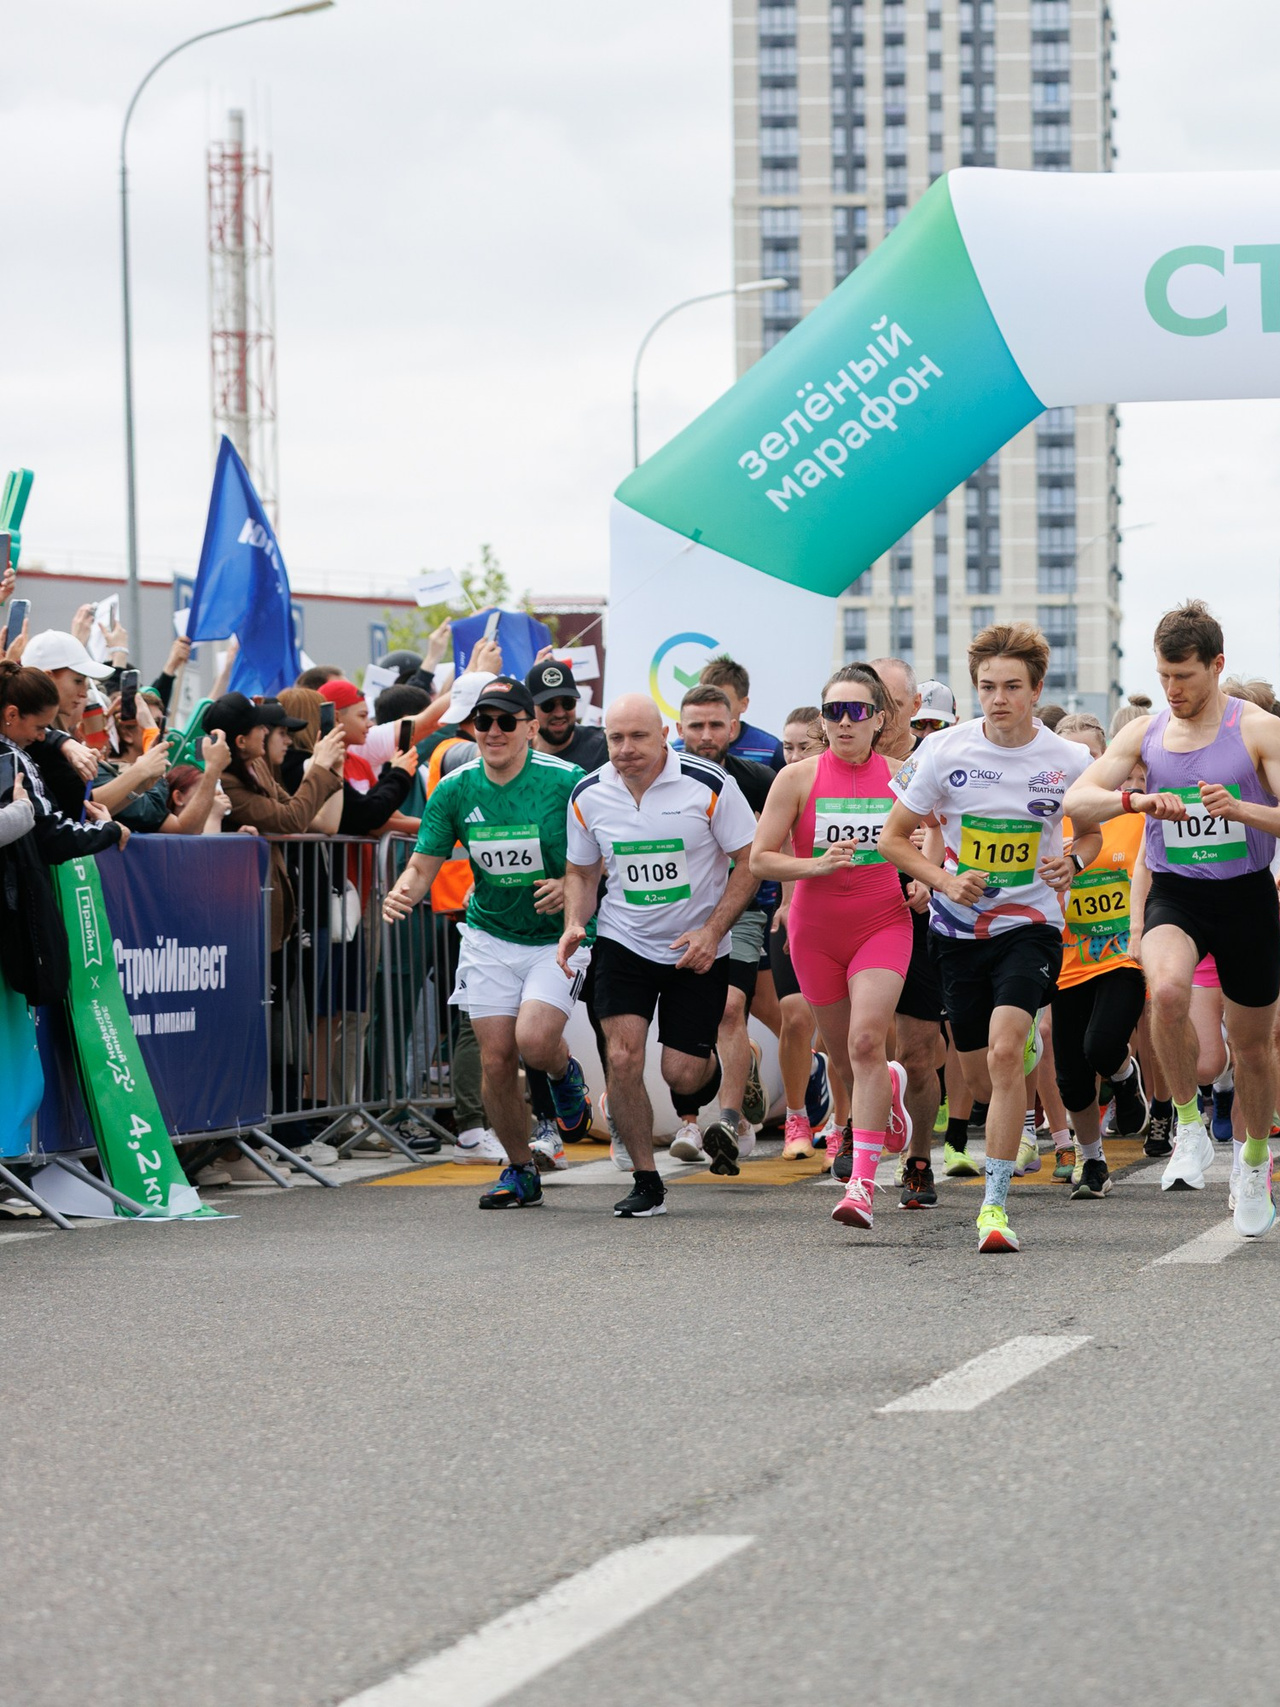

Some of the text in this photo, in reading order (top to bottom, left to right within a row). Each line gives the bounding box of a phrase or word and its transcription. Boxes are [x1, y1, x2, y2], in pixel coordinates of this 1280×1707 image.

[738, 315, 913, 481] зелёный
[765, 354, 944, 513] марафон
[1029, 786, 1065, 795] TRIATHLON
[826, 824, 884, 844] 0335
[1173, 814, 1230, 838] 1021
[481, 849, 533, 868] 0126
[973, 840, 1030, 864] 1103
[1191, 850, 1218, 861] 4,2км
[627, 862, 679, 883] 0108
[1072, 891, 1126, 917] 1302
[81, 895, 96, 952] Прайм
[112, 935, 228, 1001] СтройИнвест
[91, 999, 117, 1061] марафон
[154, 1007, 196, 1035] КОМПАНИЙ
[101, 1005, 128, 1064] зелёный
